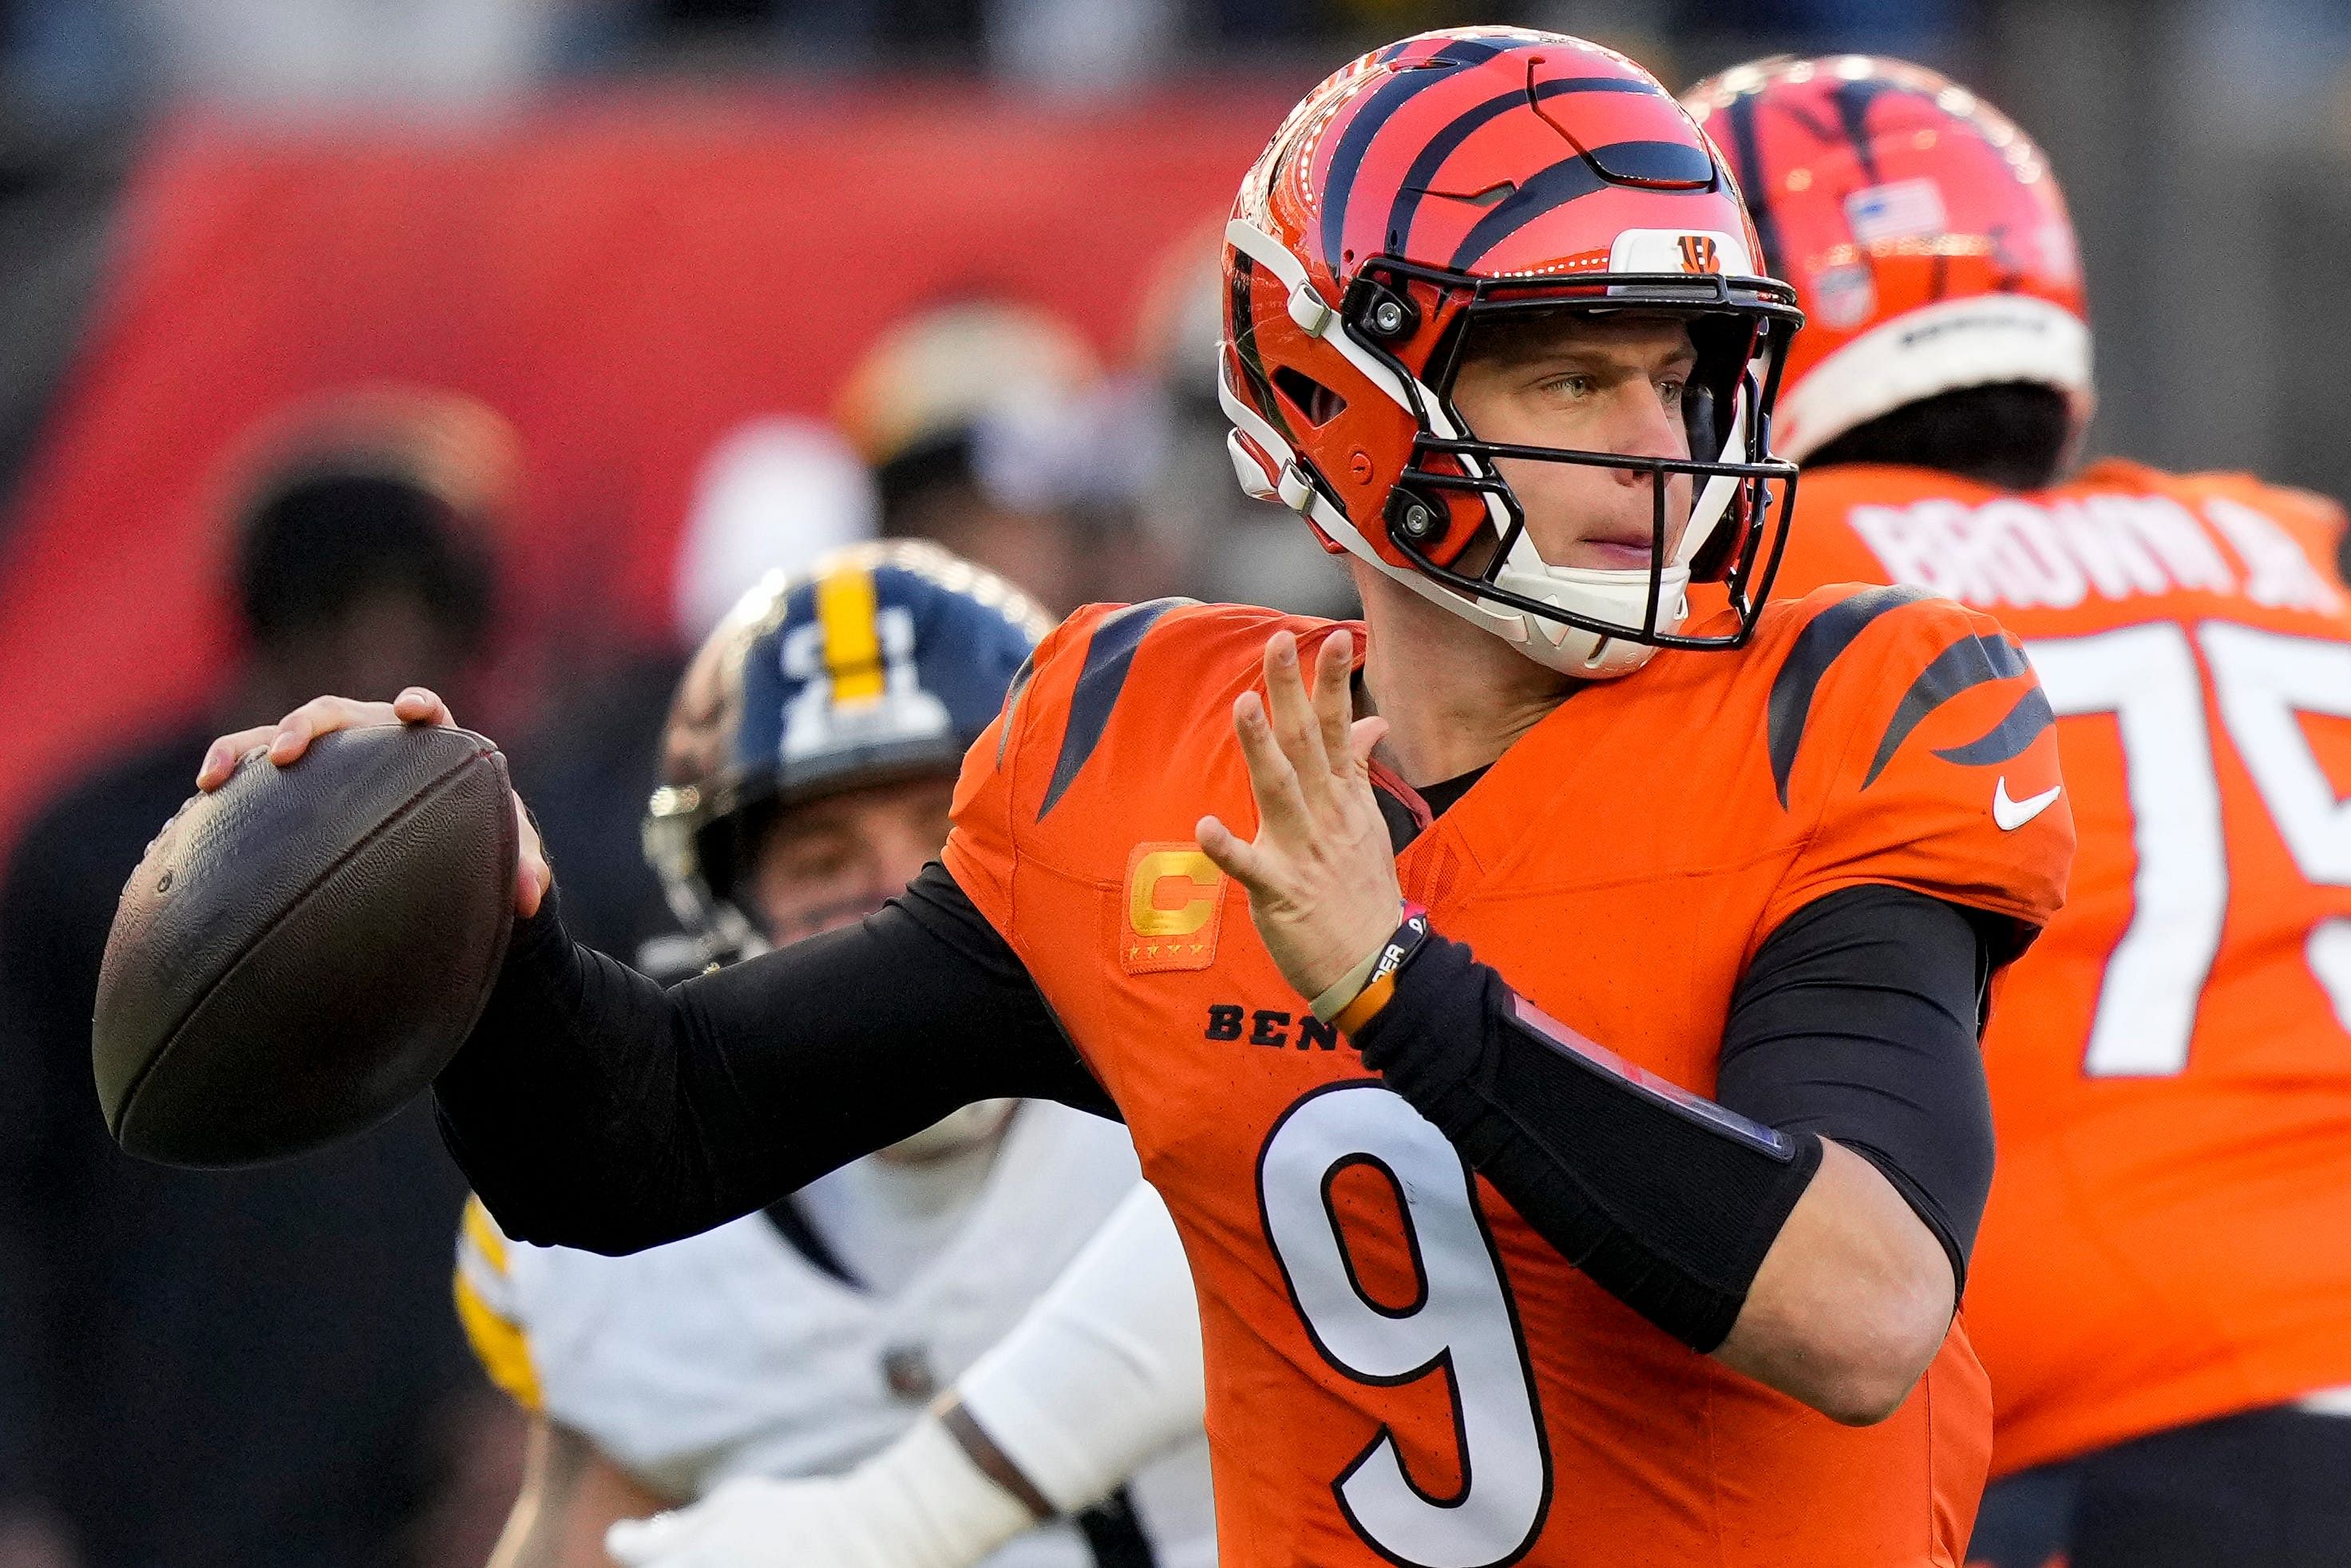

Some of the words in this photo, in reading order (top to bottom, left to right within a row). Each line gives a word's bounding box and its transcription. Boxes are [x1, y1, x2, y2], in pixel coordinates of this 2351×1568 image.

[1849, 494, 2237, 608] BROWN
[1129, 850, 1223, 937] C
[2021, 620, 2351, 1075] 75
[1204, 1004, 1338, 1051] BEN
[1256, 1079, 1553, 1568] 9
